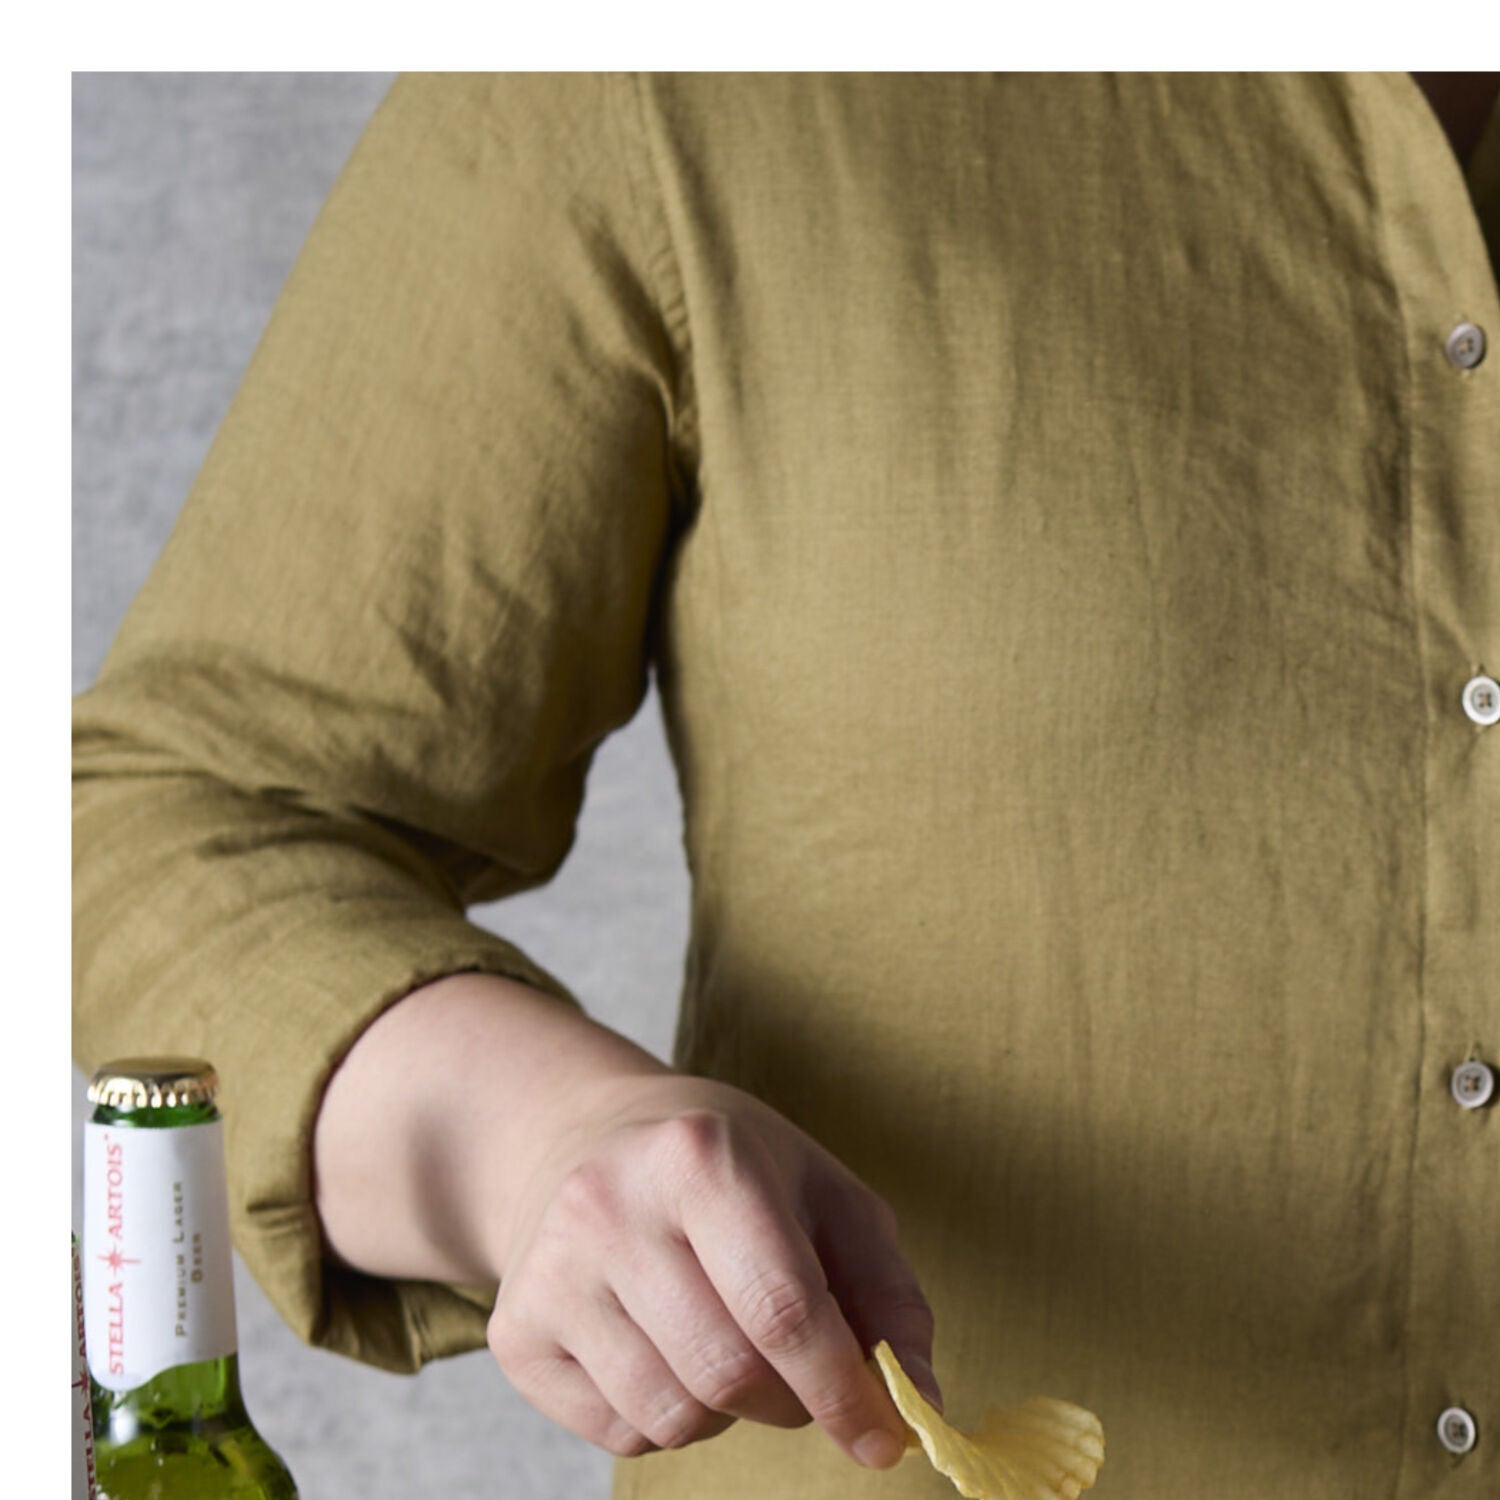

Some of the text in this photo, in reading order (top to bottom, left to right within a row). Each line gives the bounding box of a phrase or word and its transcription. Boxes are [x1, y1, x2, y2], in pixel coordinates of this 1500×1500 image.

[106, 1143, 124, 1376] STELLA ARTOIS
[172, 1181, 187, 1337] PREMIUM LAGER
